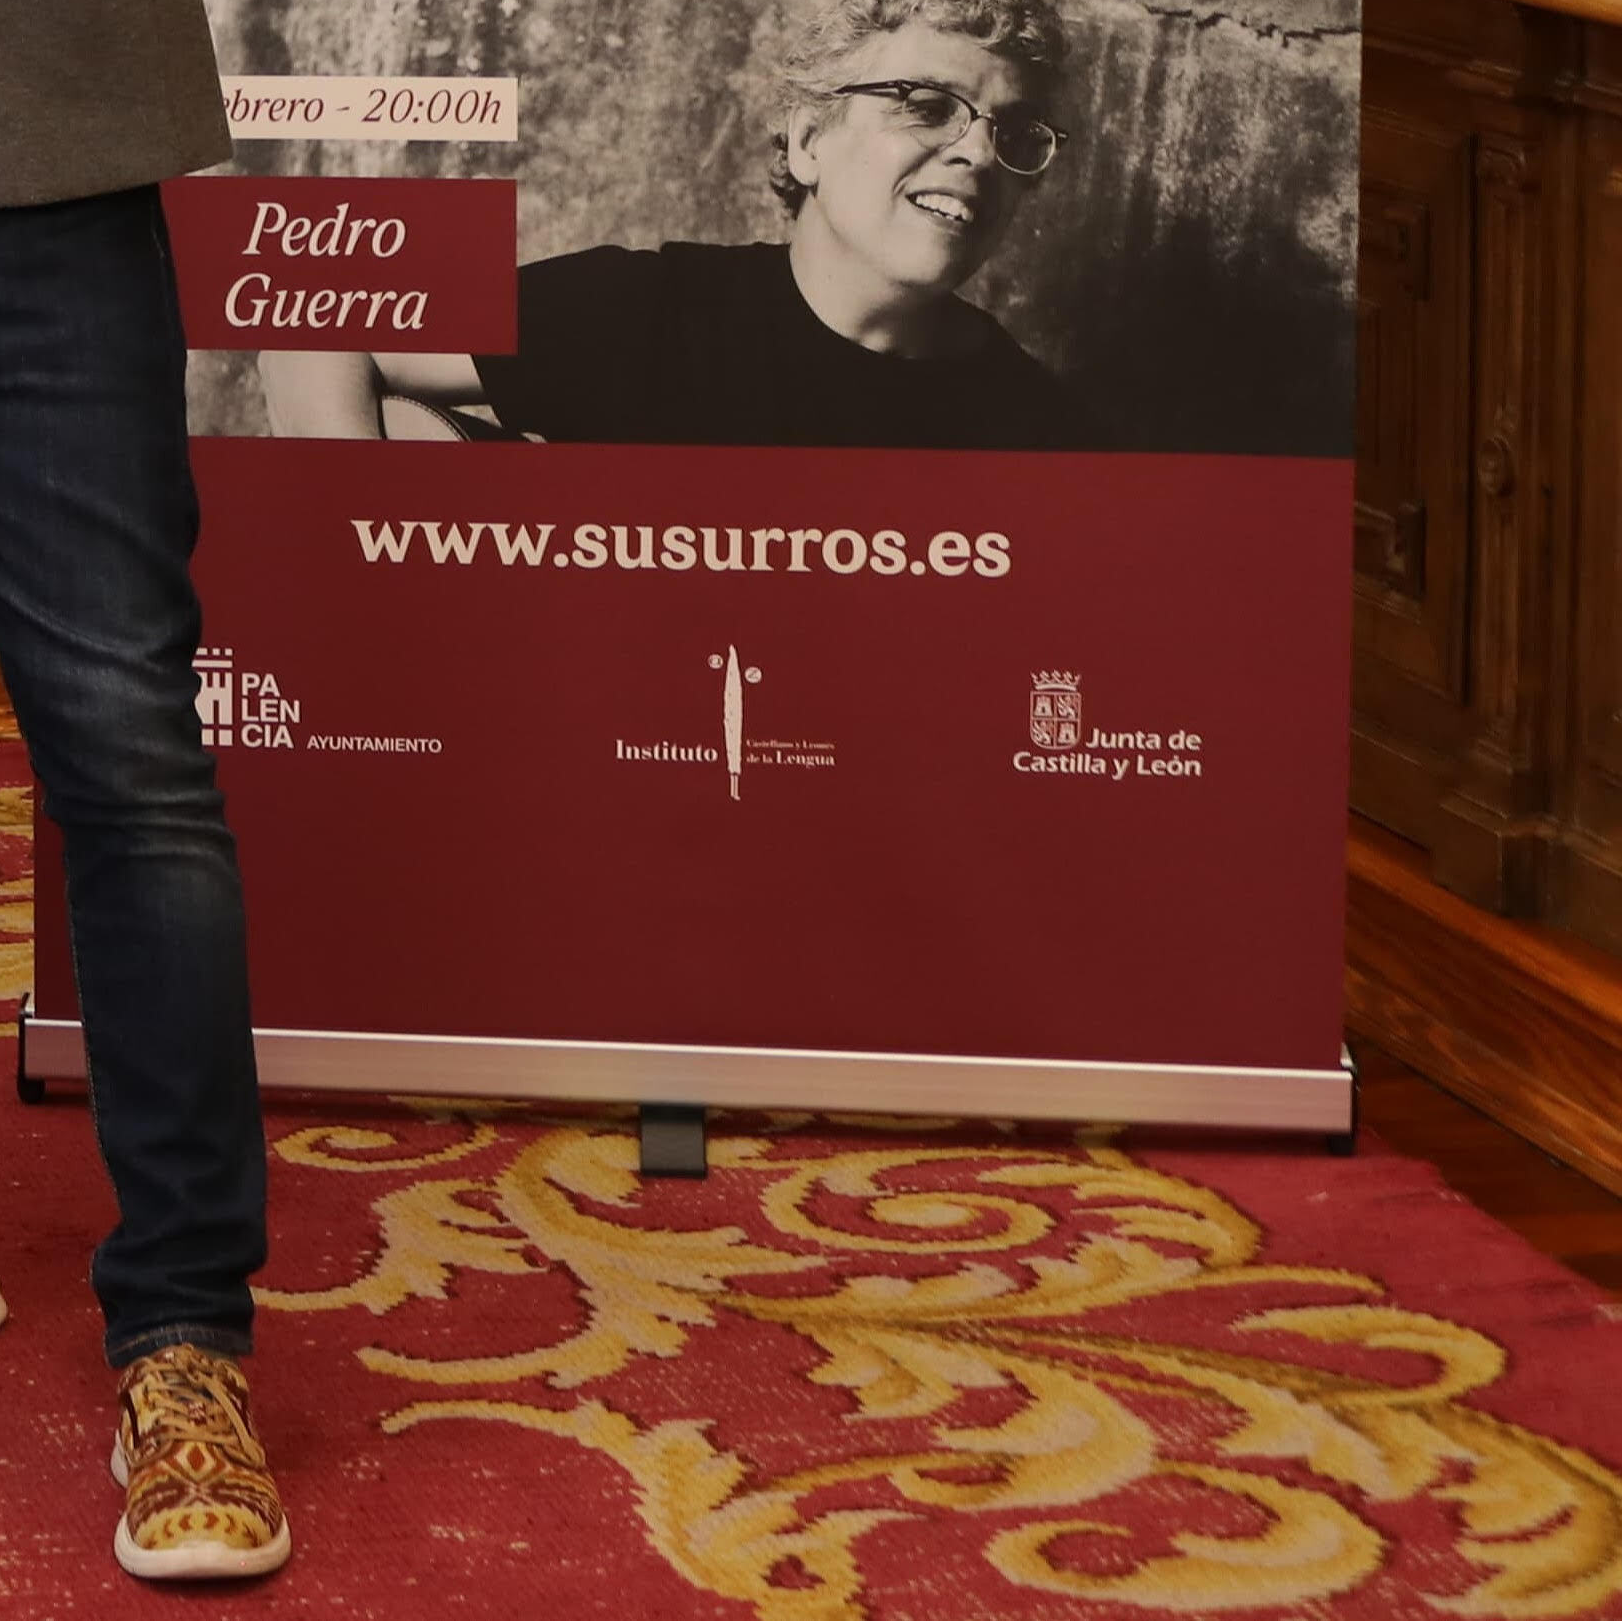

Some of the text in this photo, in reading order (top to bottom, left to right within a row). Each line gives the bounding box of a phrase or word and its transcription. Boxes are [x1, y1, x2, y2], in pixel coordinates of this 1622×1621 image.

[361, 88, 501, 124] 20:00h
[241, 202, 406, 258] Pedro
[225, 272, 428, 330] Guerra
[350, 519, 1011, 578] www.susurros.es
[242, 673, 280, 697] PA
[240, 697, 301, 724] LEN
[242, 724, 441, 753] CIA AYUNTAMIENTO
[617, 740, 717, 761] Instituto
[1086, 728, 1203, 753] Junta de
[777, 751, 834, 766] Lengua
[1014, 752, 1201, 781] Castilla y León
